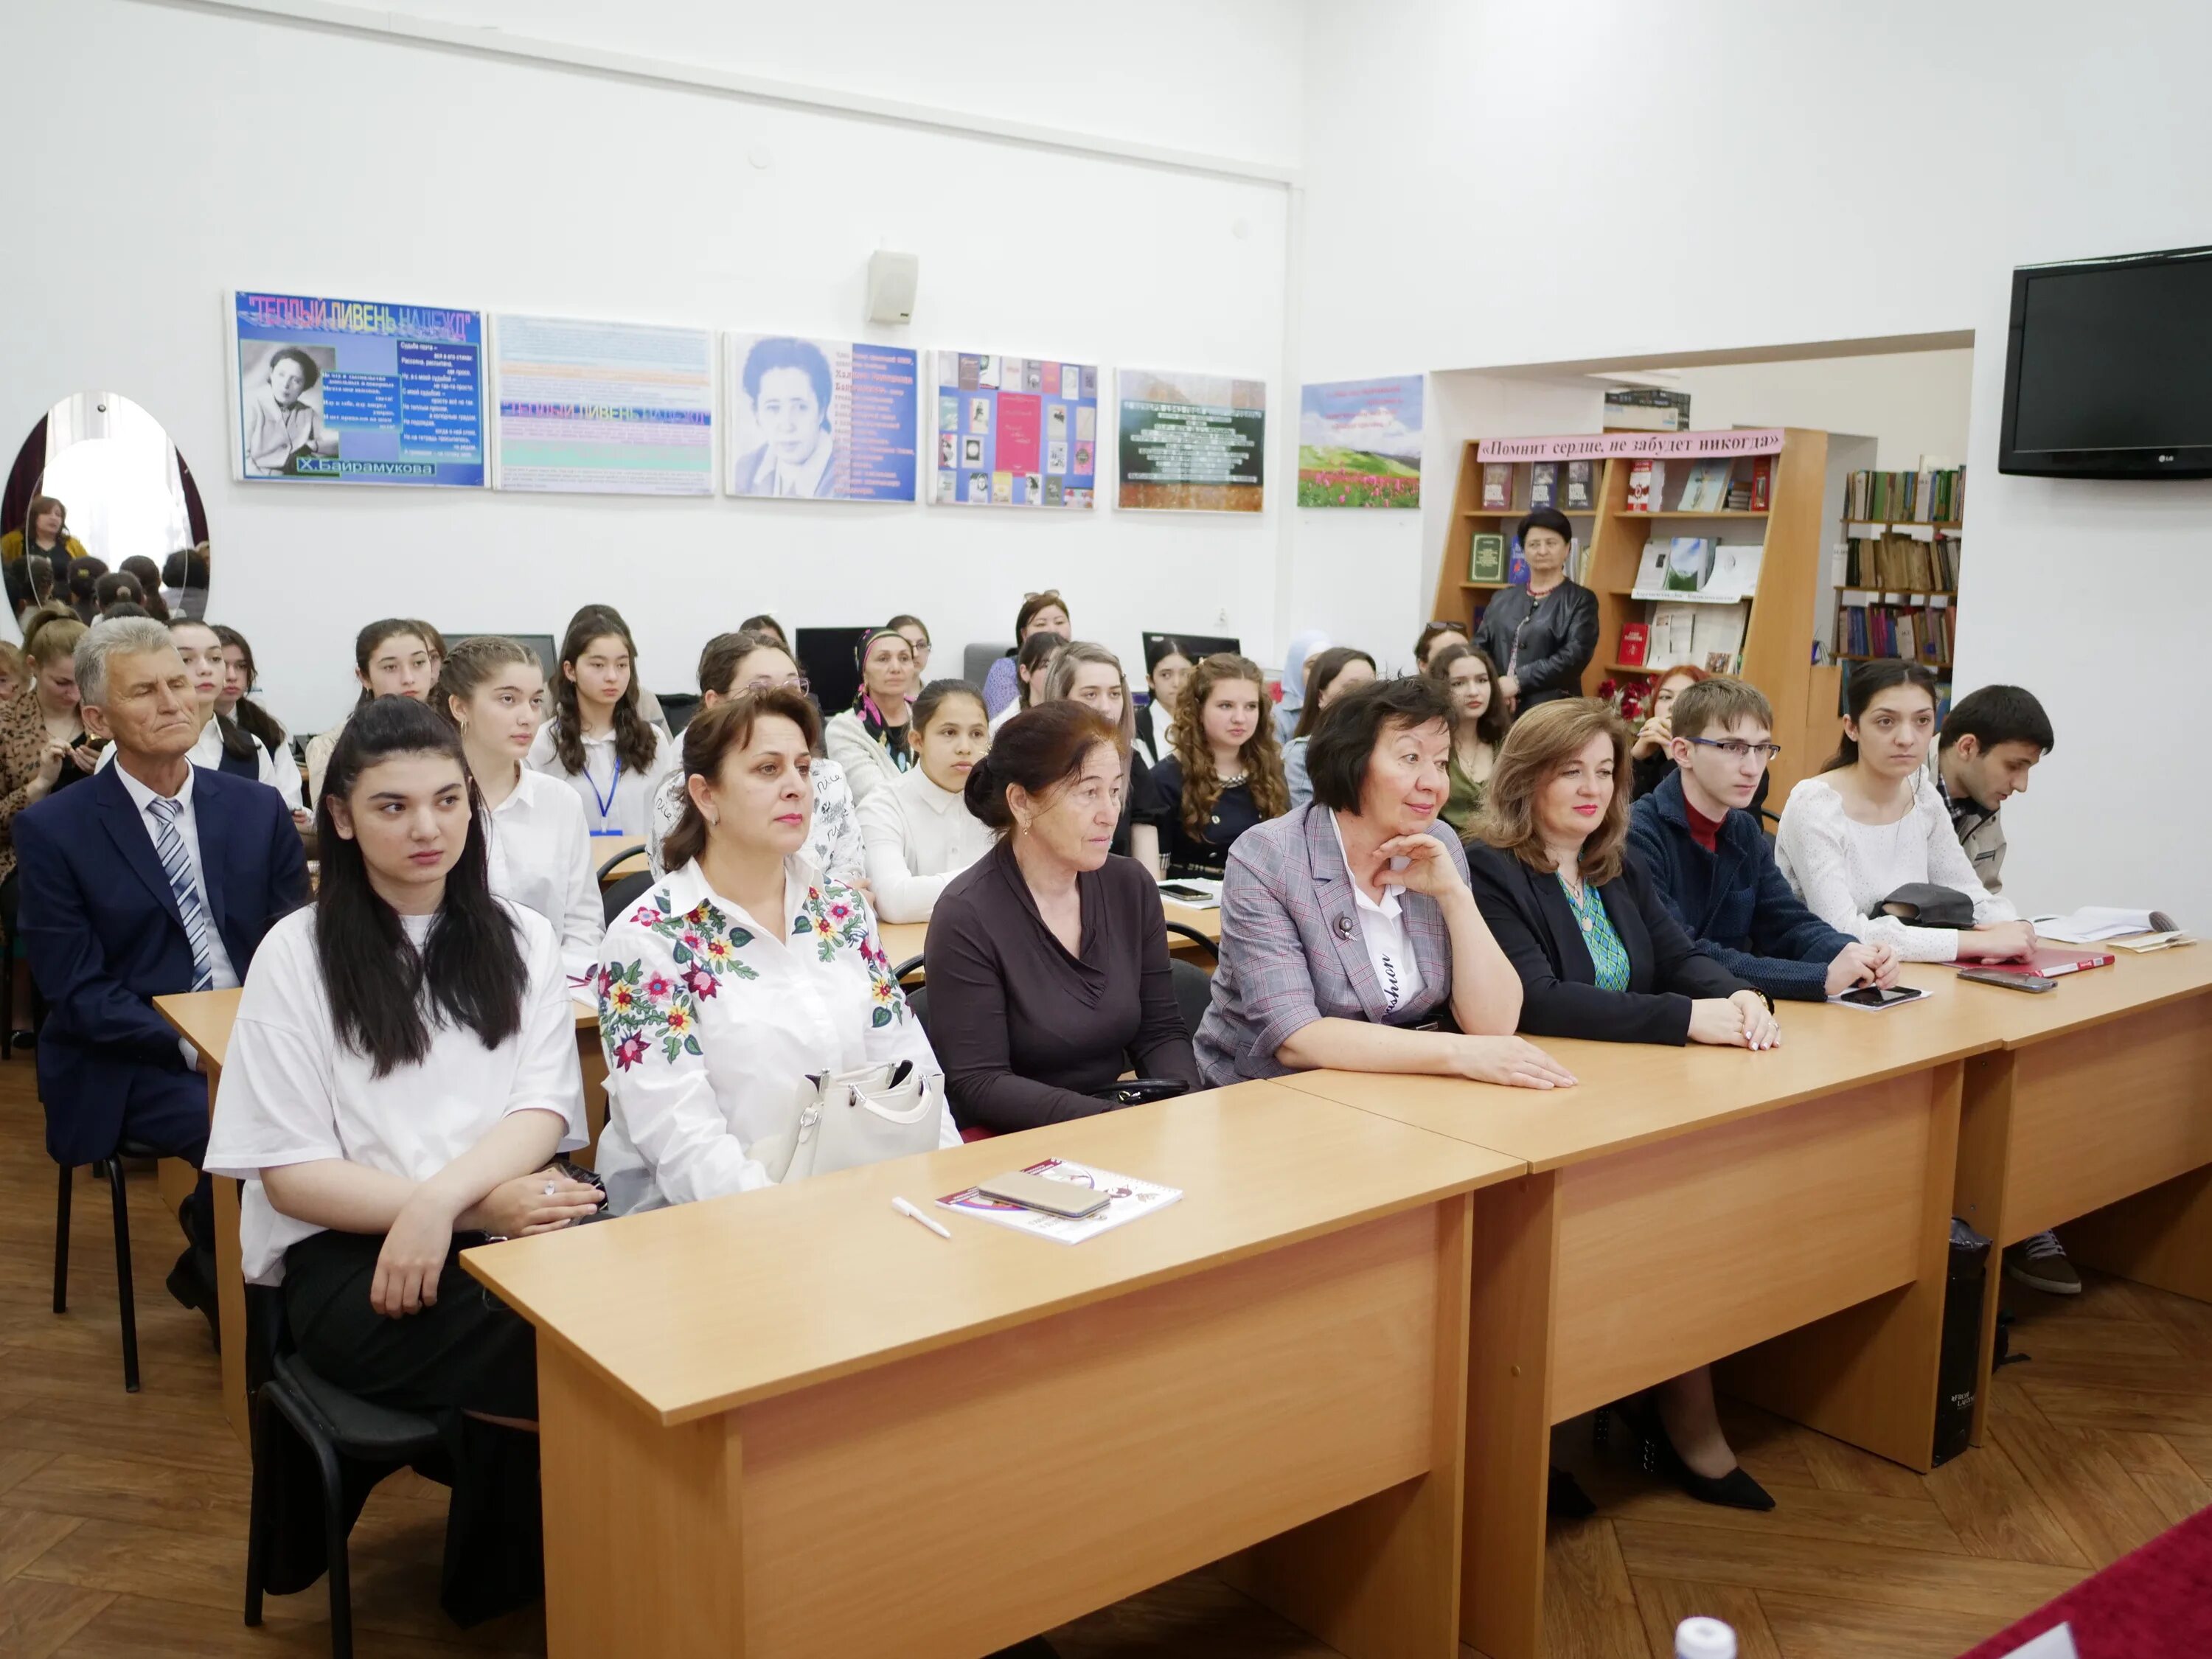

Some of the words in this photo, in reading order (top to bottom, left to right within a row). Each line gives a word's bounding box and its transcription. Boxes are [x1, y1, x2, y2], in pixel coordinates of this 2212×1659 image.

[331, 302, 395, 333] ЛИВЕНЬ
[1482, 440, 1546, 456] «Помнит
[1553, 440, 1604, 457] сердце,
[1610, 440, 1627, 452] не
[1632, 436, 1692, 456] забудет
[1700, 434, 1779, 452] никогда»
